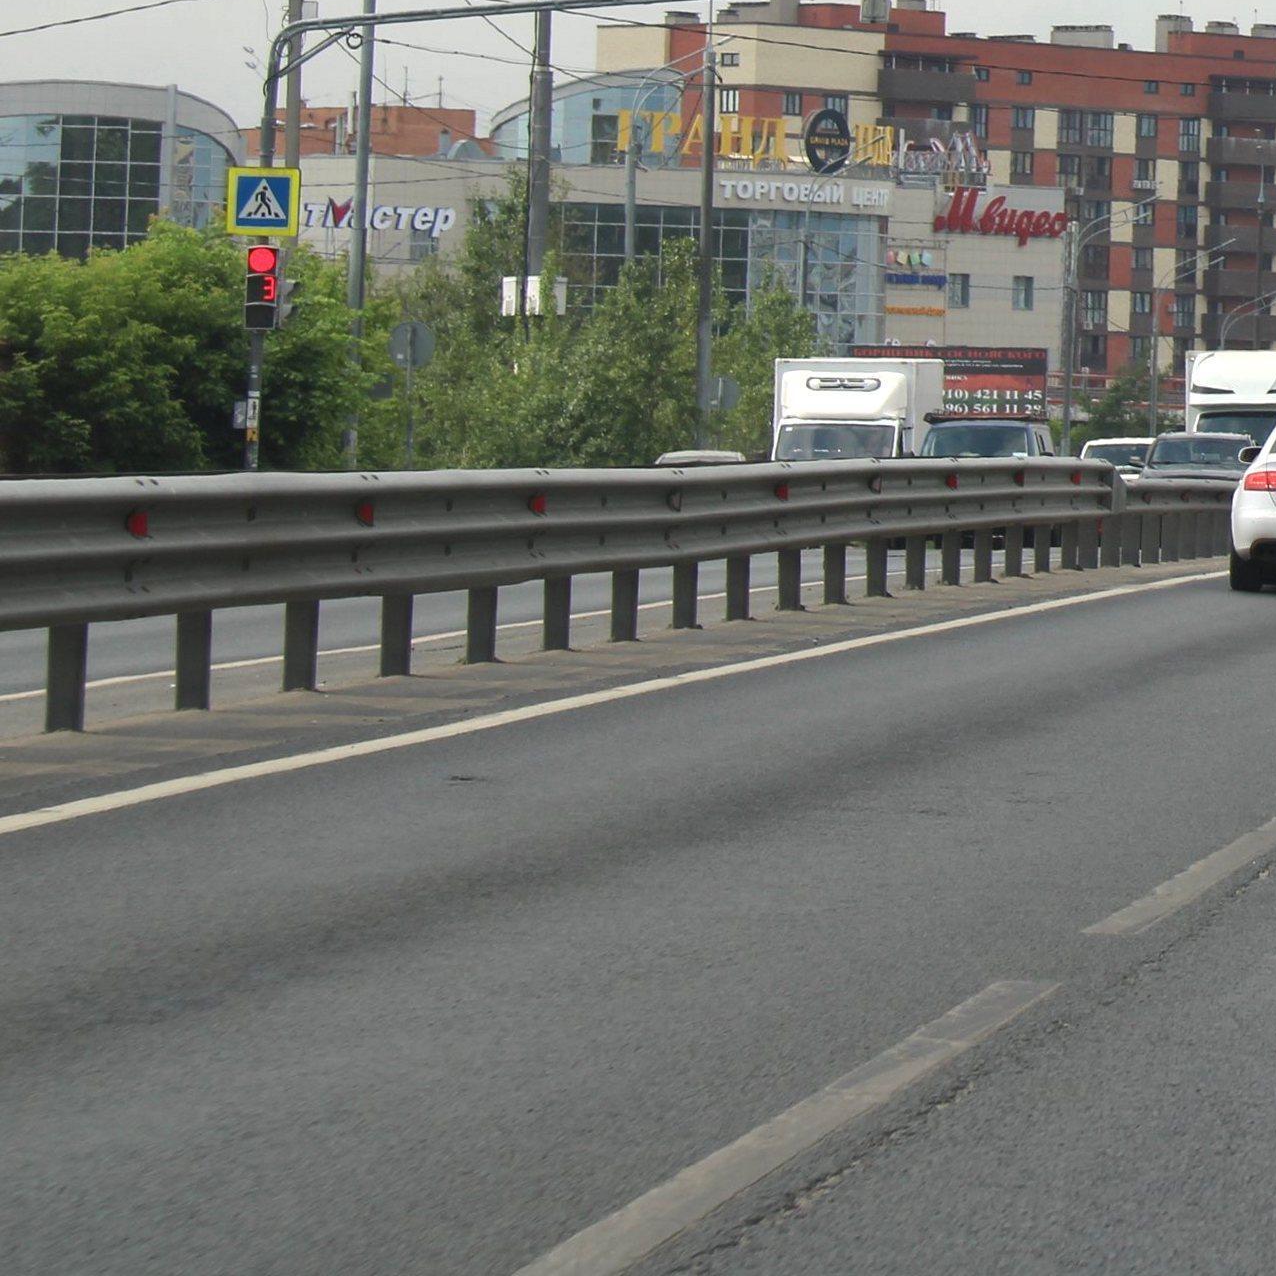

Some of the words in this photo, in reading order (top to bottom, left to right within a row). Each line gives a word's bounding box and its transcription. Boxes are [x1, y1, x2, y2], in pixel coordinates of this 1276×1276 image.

[720, 179, 845, 204] ТОРГОВЫЙ
[262, 276, 276, 301] 3
[973, 389, 998, 399] 421
[1005, 390, 1019, 400] 11
[1024, 390, 1043, 400] 45
[973, 403, 998, 414] 561
[1005, 404, 1018, 414] 11
